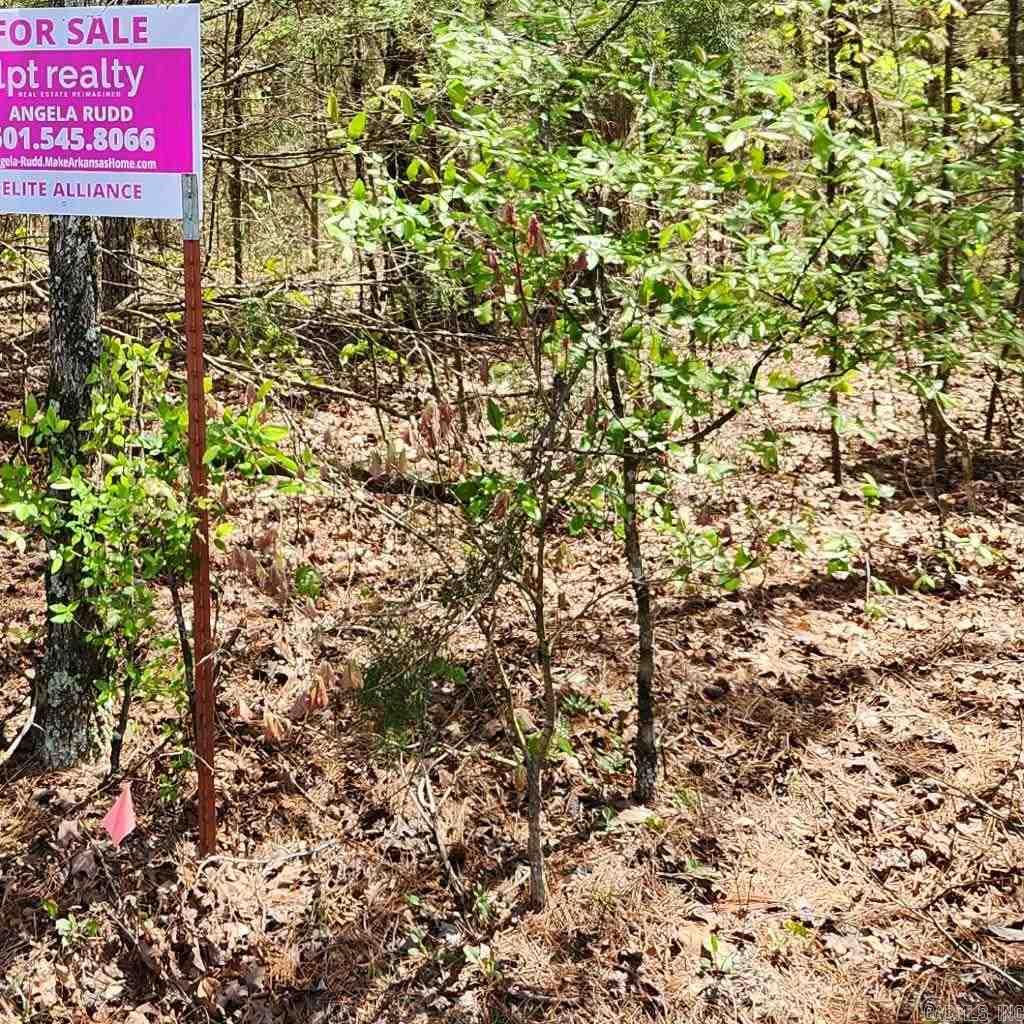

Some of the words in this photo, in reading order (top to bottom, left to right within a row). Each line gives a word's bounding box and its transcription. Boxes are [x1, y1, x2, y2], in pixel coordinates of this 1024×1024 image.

[67, 16, 149, 45] SALE
[47, 57, 144, 97] realty
[9, 106, 77, 122] ANGELA
[83, 106, 133, 122] RUDD
[2, 181, 47, 197] ELITE
[53, 182, 142, 200] ALLIANCE
